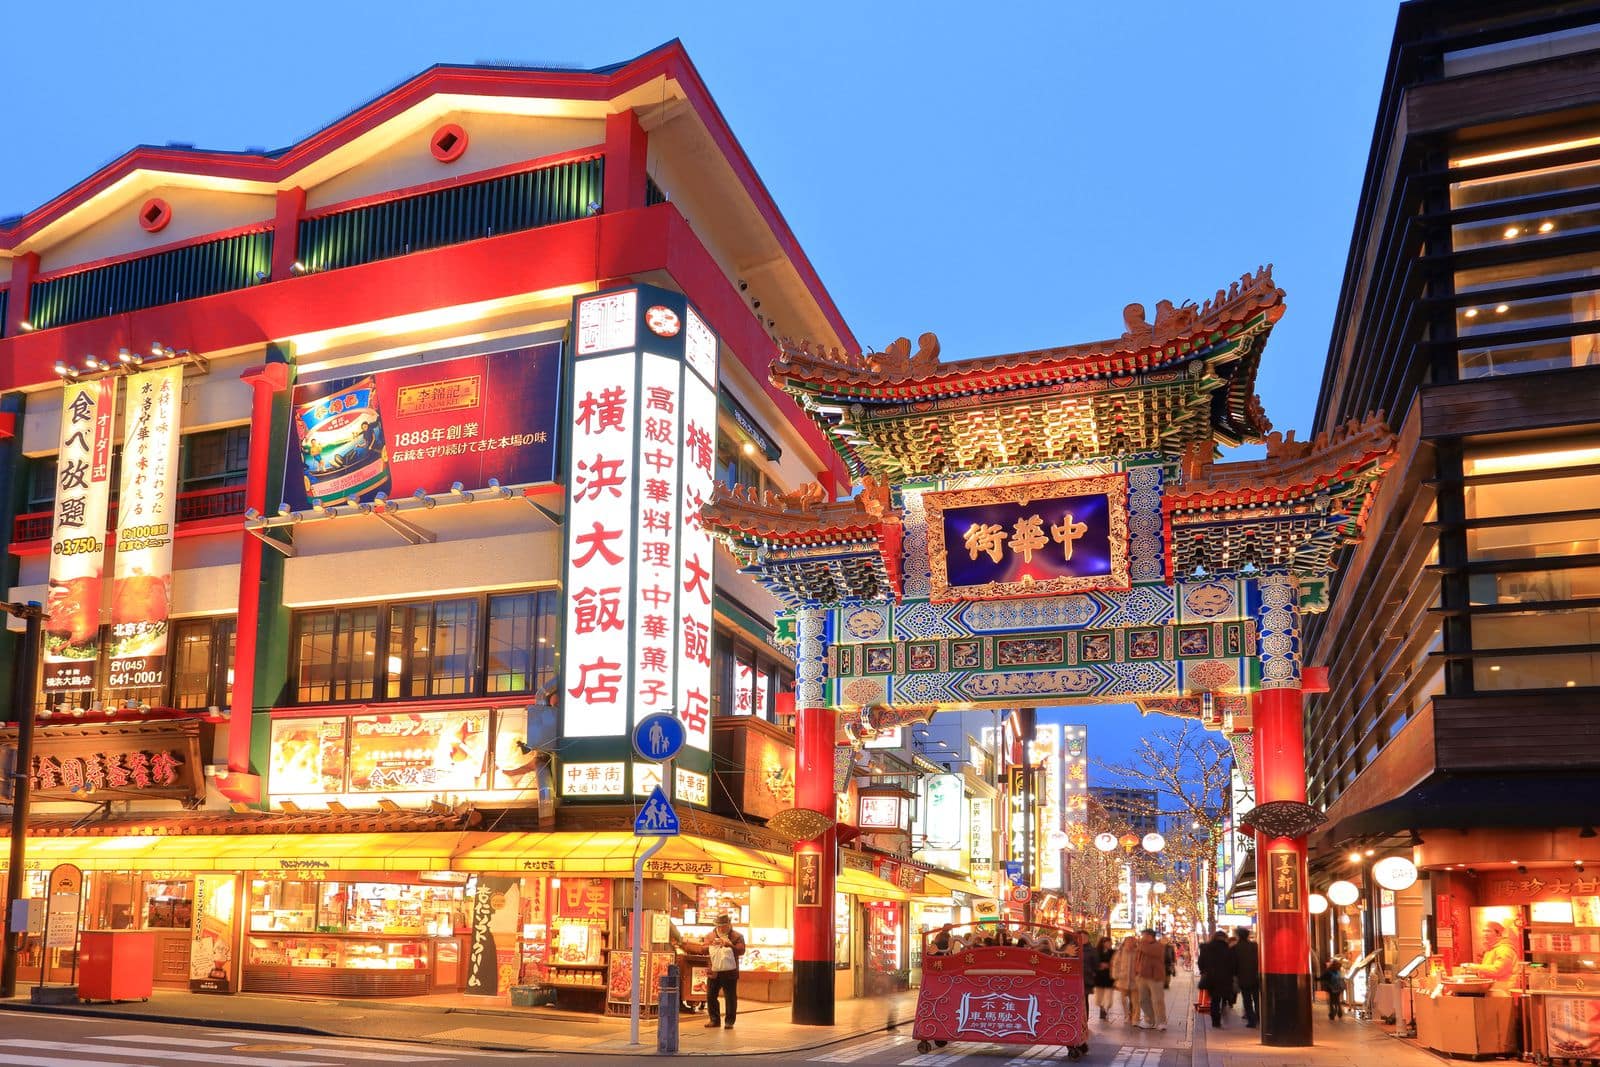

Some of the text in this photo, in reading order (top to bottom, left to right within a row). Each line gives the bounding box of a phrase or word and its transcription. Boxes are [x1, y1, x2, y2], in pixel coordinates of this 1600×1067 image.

[394, 422, 480, 447] 1888年創業
[93, 413, 110, 478] オーダー式
[392, 431, 548, 463] 伝統を守り続けてきた本場の味
[58, 390, 95, 529] 食べ放題
[568, 385, 628, 706] 横浜大飯店
[639, 386, 675, 706] 高級中華料理・中華菓子
[112, 619, 167, 637] 北京ダック
[109, 671, 163, 685] 641-0001
[370, 767, 439, 787] 食べ放題
[567, 766, 621, 781] 中華街
[678, 773, 706, 793] 中華街
[567, 784, 621, 793] 大通り入口
[647, 861, 713, 873] 横浜大飯店
[1015, 889, 1028, 900] 30
